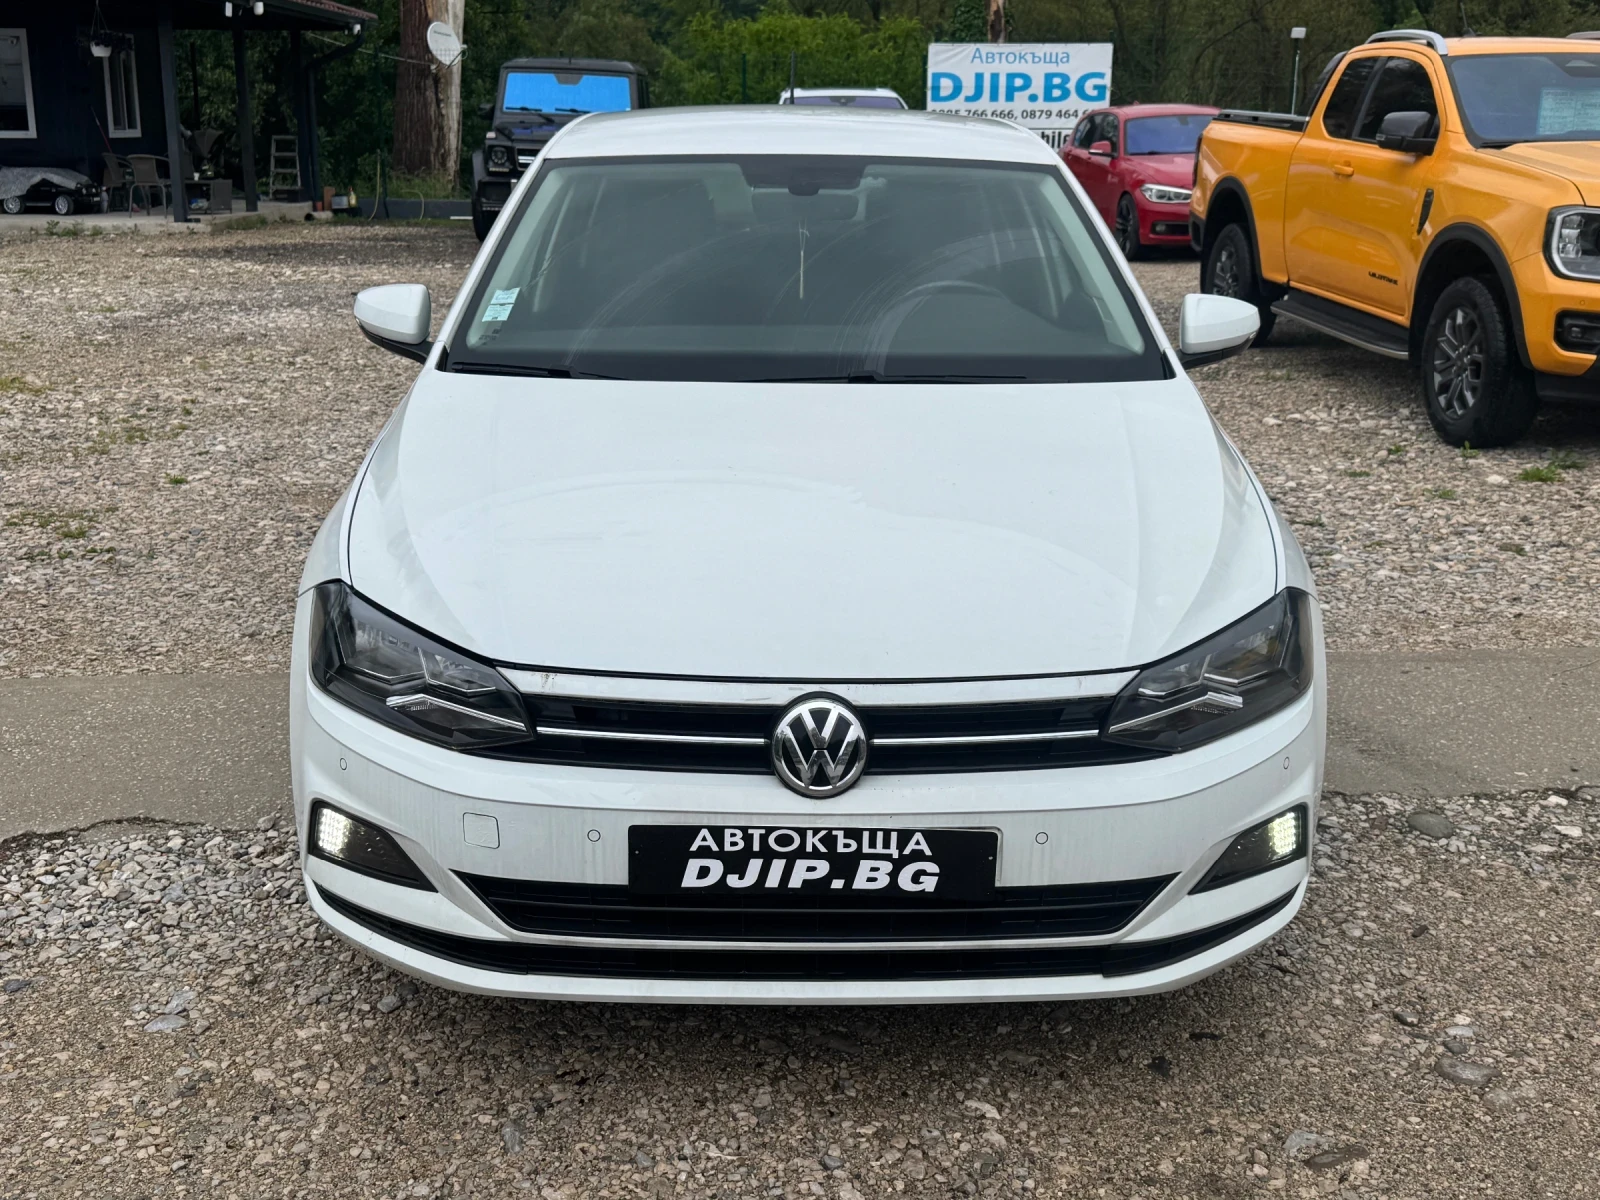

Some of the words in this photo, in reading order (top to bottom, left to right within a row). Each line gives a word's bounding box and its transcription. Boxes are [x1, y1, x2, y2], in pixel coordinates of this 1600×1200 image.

[970, 47, 1070, 67] Автокъща
[930, 72, 1107, 103] DJIP.BG
[1021, 109, 1053, 120] 0879
[1055, 109, 1079, 120] 464
[689, 828, 932, 859] АВТОКЪЩА
[681, 858, 940, 892] DJIP.BG
